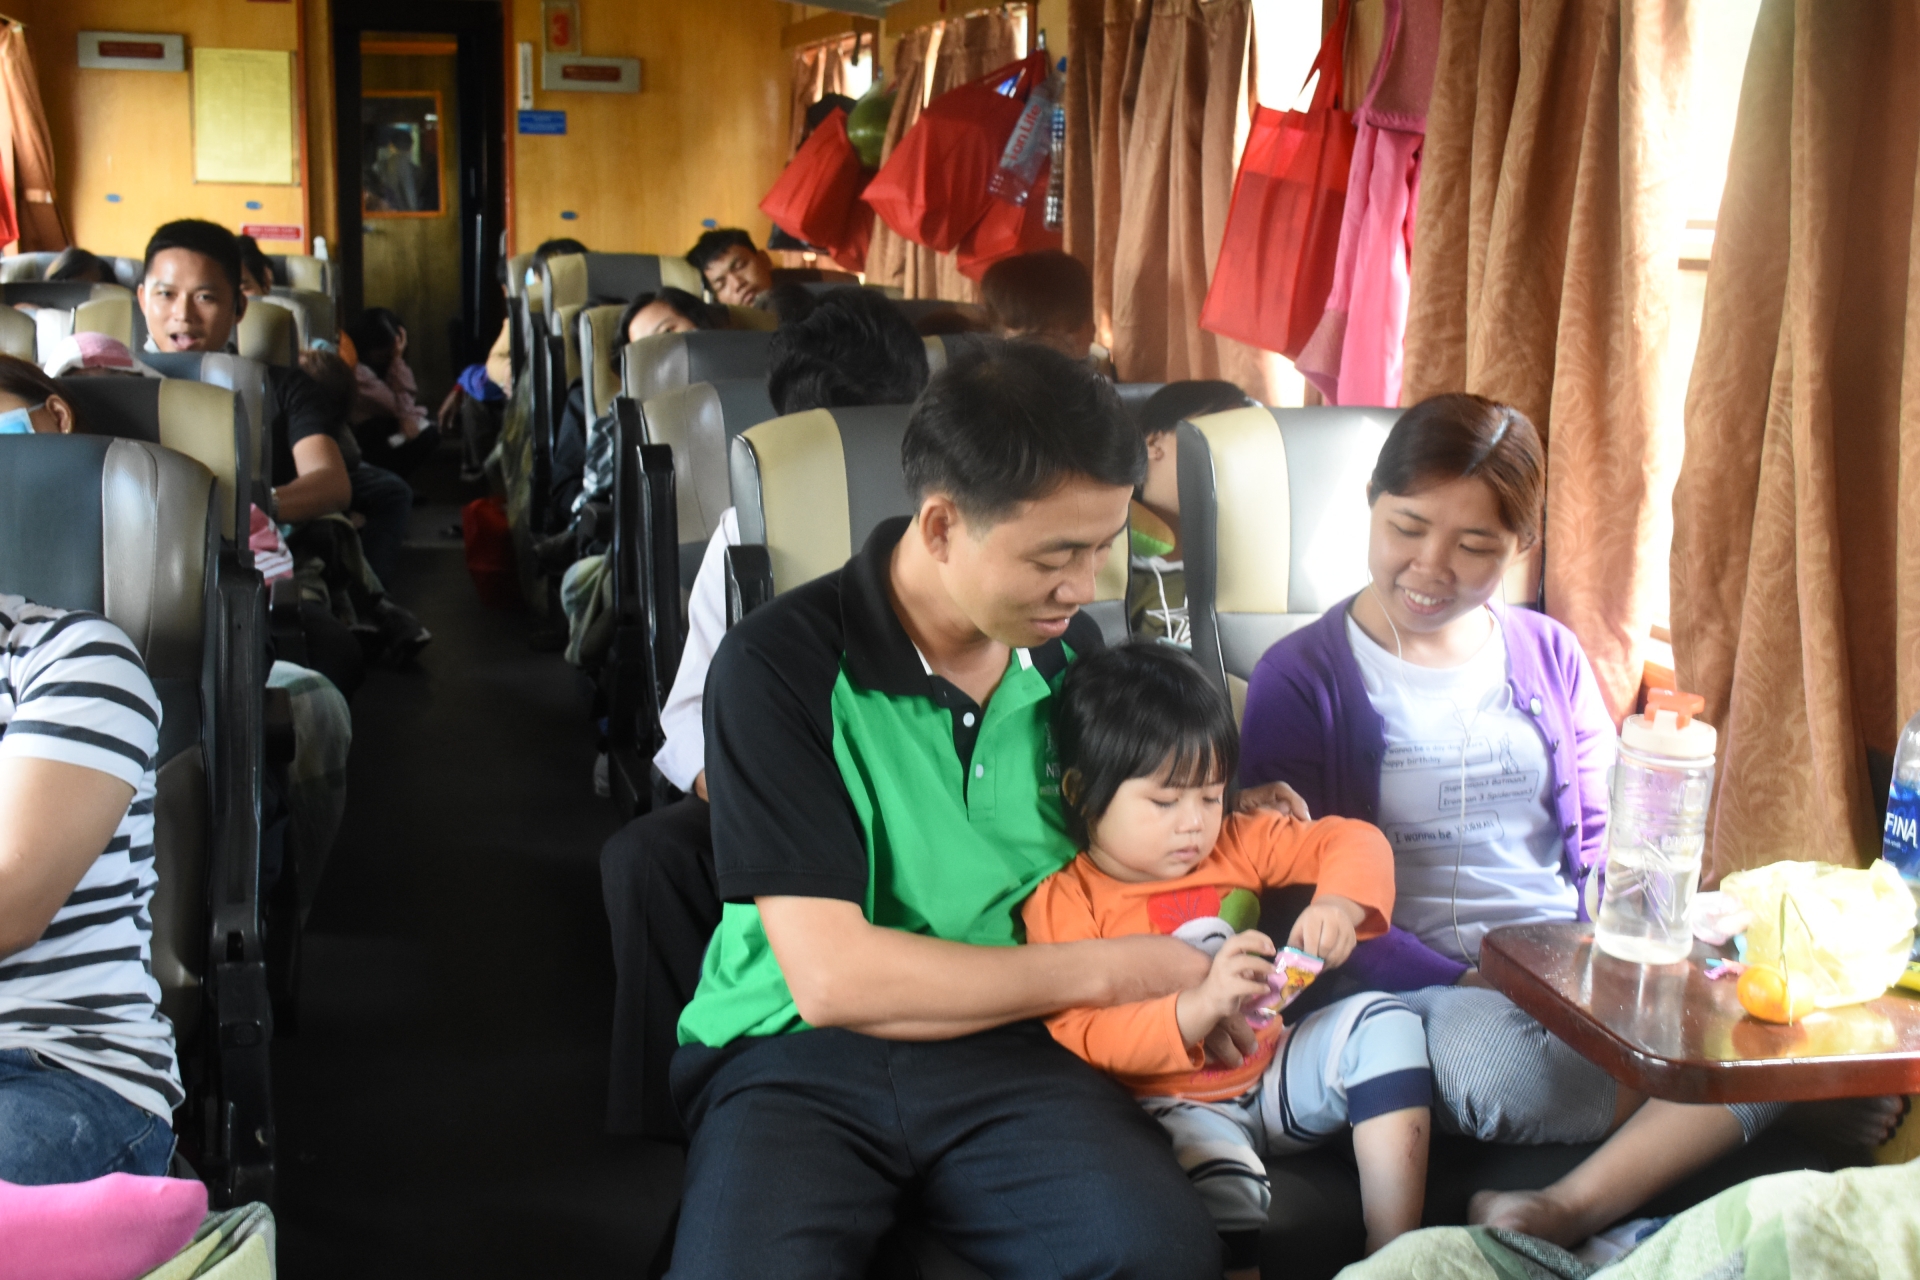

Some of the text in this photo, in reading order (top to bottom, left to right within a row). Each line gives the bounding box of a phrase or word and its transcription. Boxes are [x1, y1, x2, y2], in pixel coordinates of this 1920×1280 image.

[552, 13, 570, 46] 3
[1388, 745, 1412, 755] wanna
[1406, 755, 1441, 765] birthday
[1394, 832, 1401, 843] I
[1404, 831, 1436, 842] wanna
[1438, 829, 1452, 840] be
